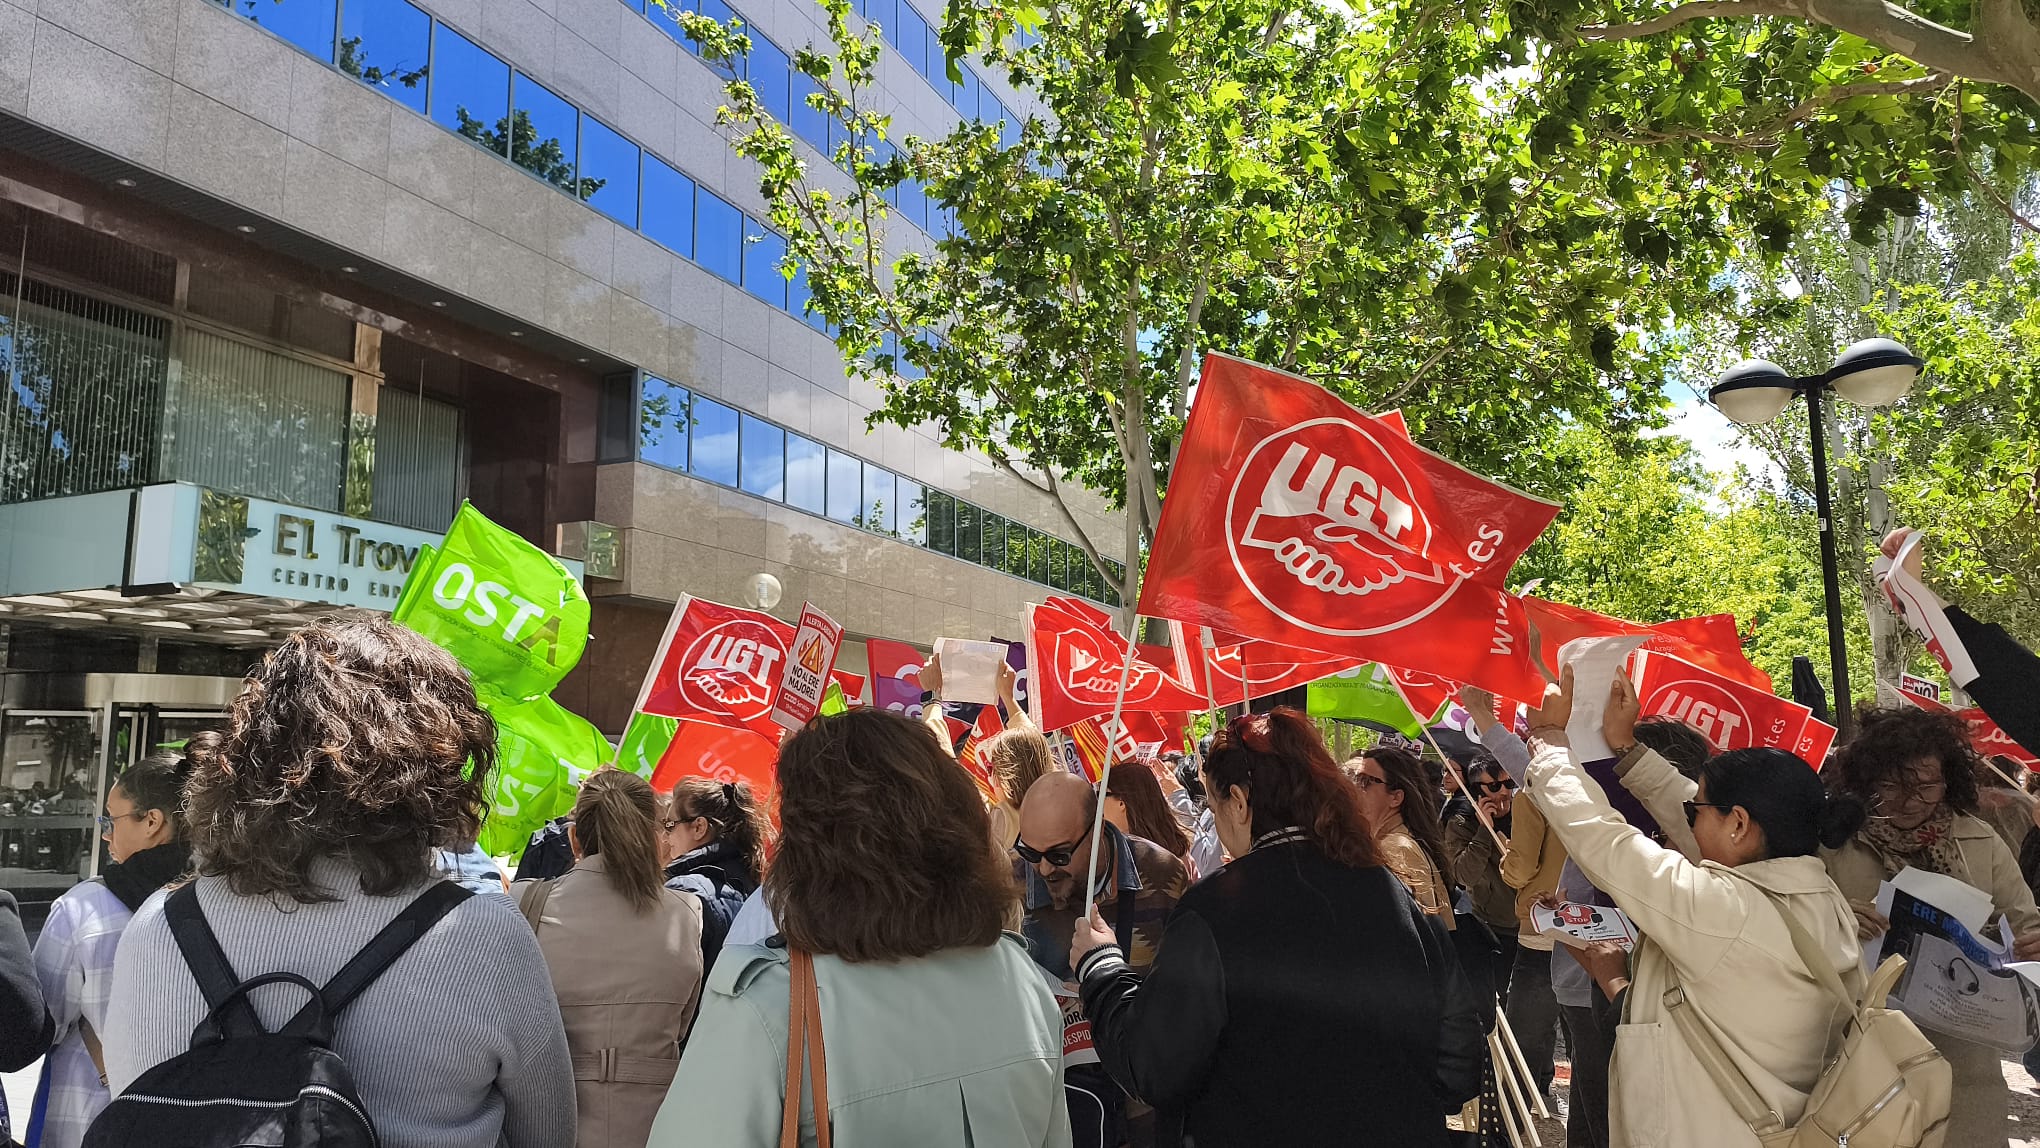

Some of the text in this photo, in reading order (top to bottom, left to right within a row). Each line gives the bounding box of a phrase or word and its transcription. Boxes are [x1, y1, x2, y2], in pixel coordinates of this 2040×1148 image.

[1260, 441, 1413, 539] UGT
[335, 524, 419, 574] Trov
[272, 567, 349, 592] CENTRO
[696, 633, 780, 685] UGT
[788, 676, 816, 701] MAJOREL
[792, 665, 802, 678] NO
[808, 674, 820, 689] ERE
[1656, 689, 1741, 751] UGT
[1912, 902, 1938, 925] ERE
[1064, 1029, 1092, 1048] DESPID
